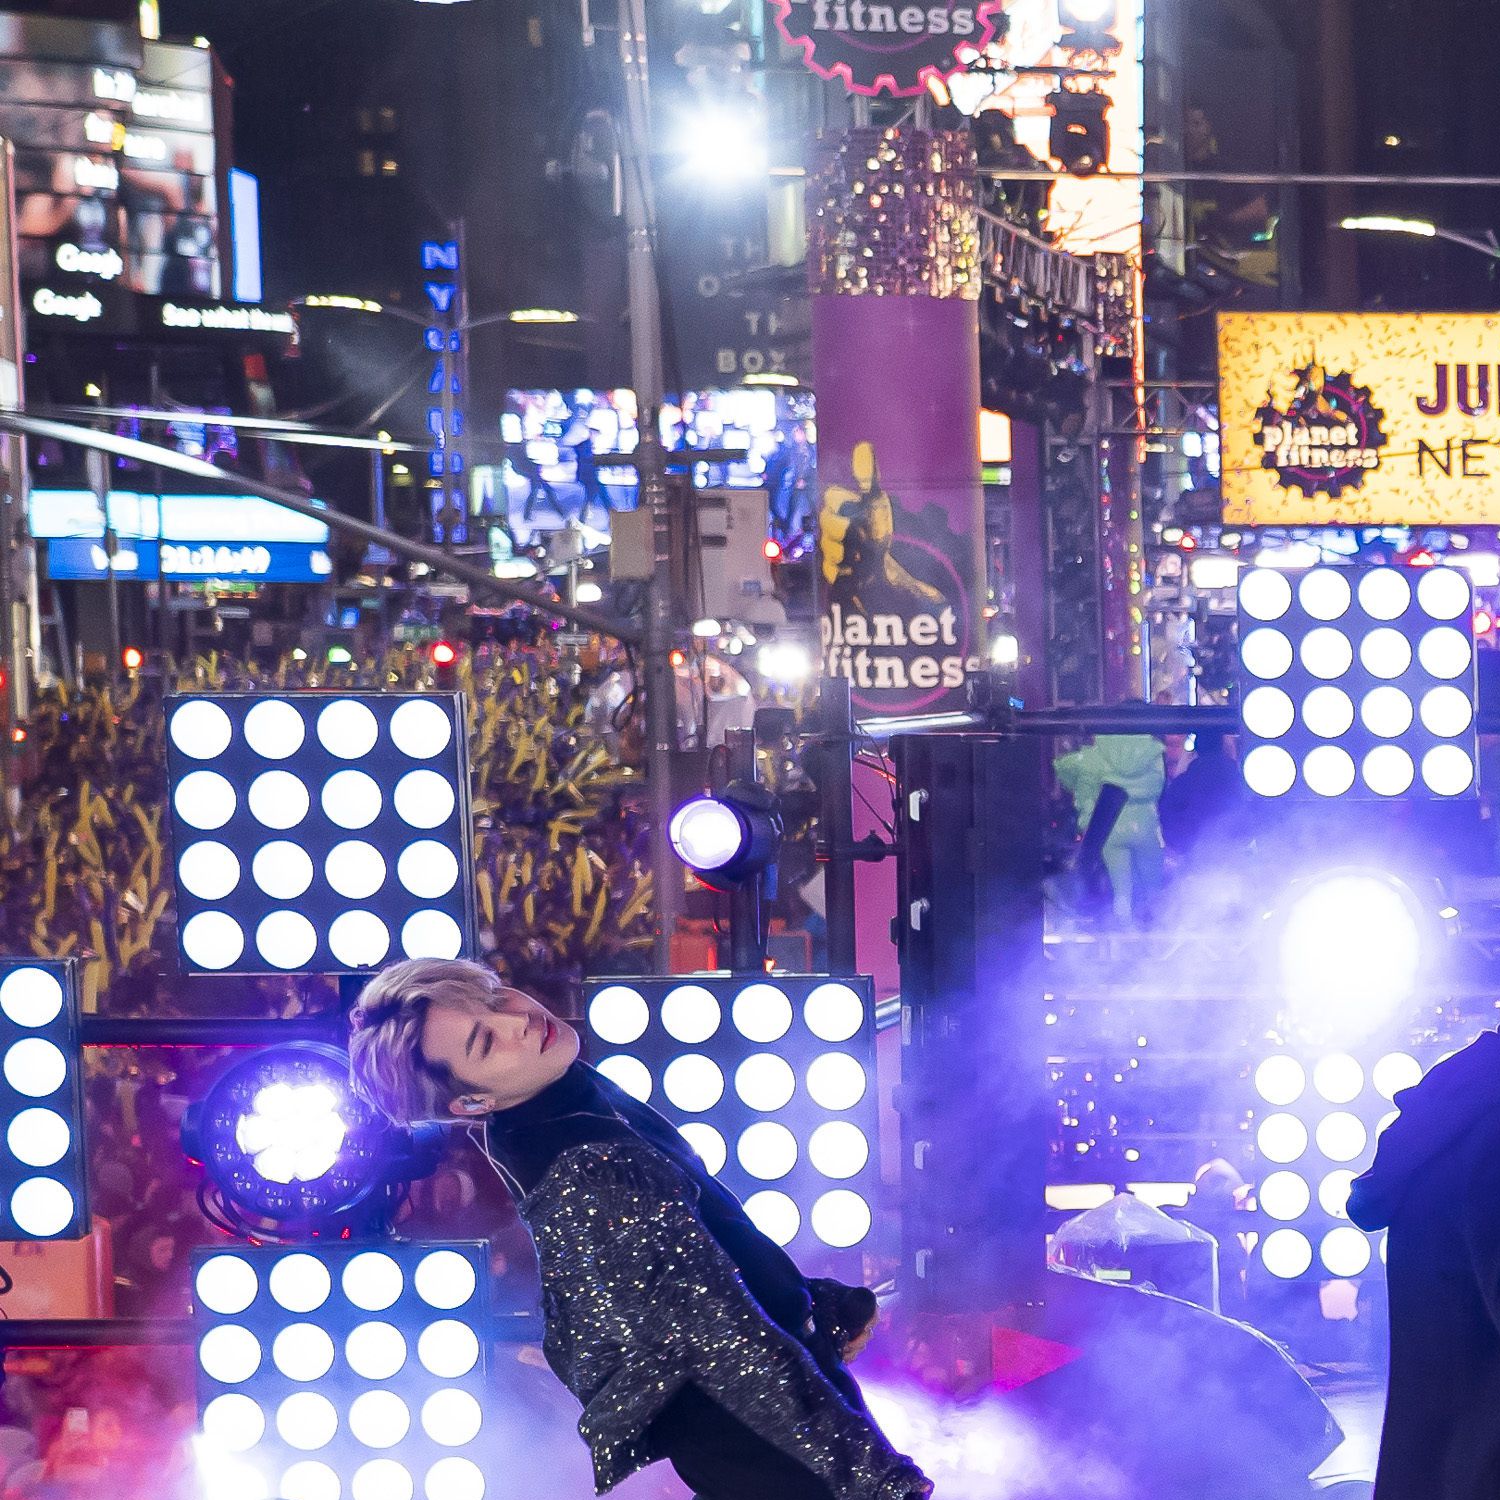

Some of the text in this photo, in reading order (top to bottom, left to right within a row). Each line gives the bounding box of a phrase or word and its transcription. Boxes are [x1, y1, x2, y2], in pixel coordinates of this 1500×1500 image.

[813, 0, 975, 34] fitness
[1263, 420, 1359, 452] planet
[1276, 444, 1379, 468] fitness
